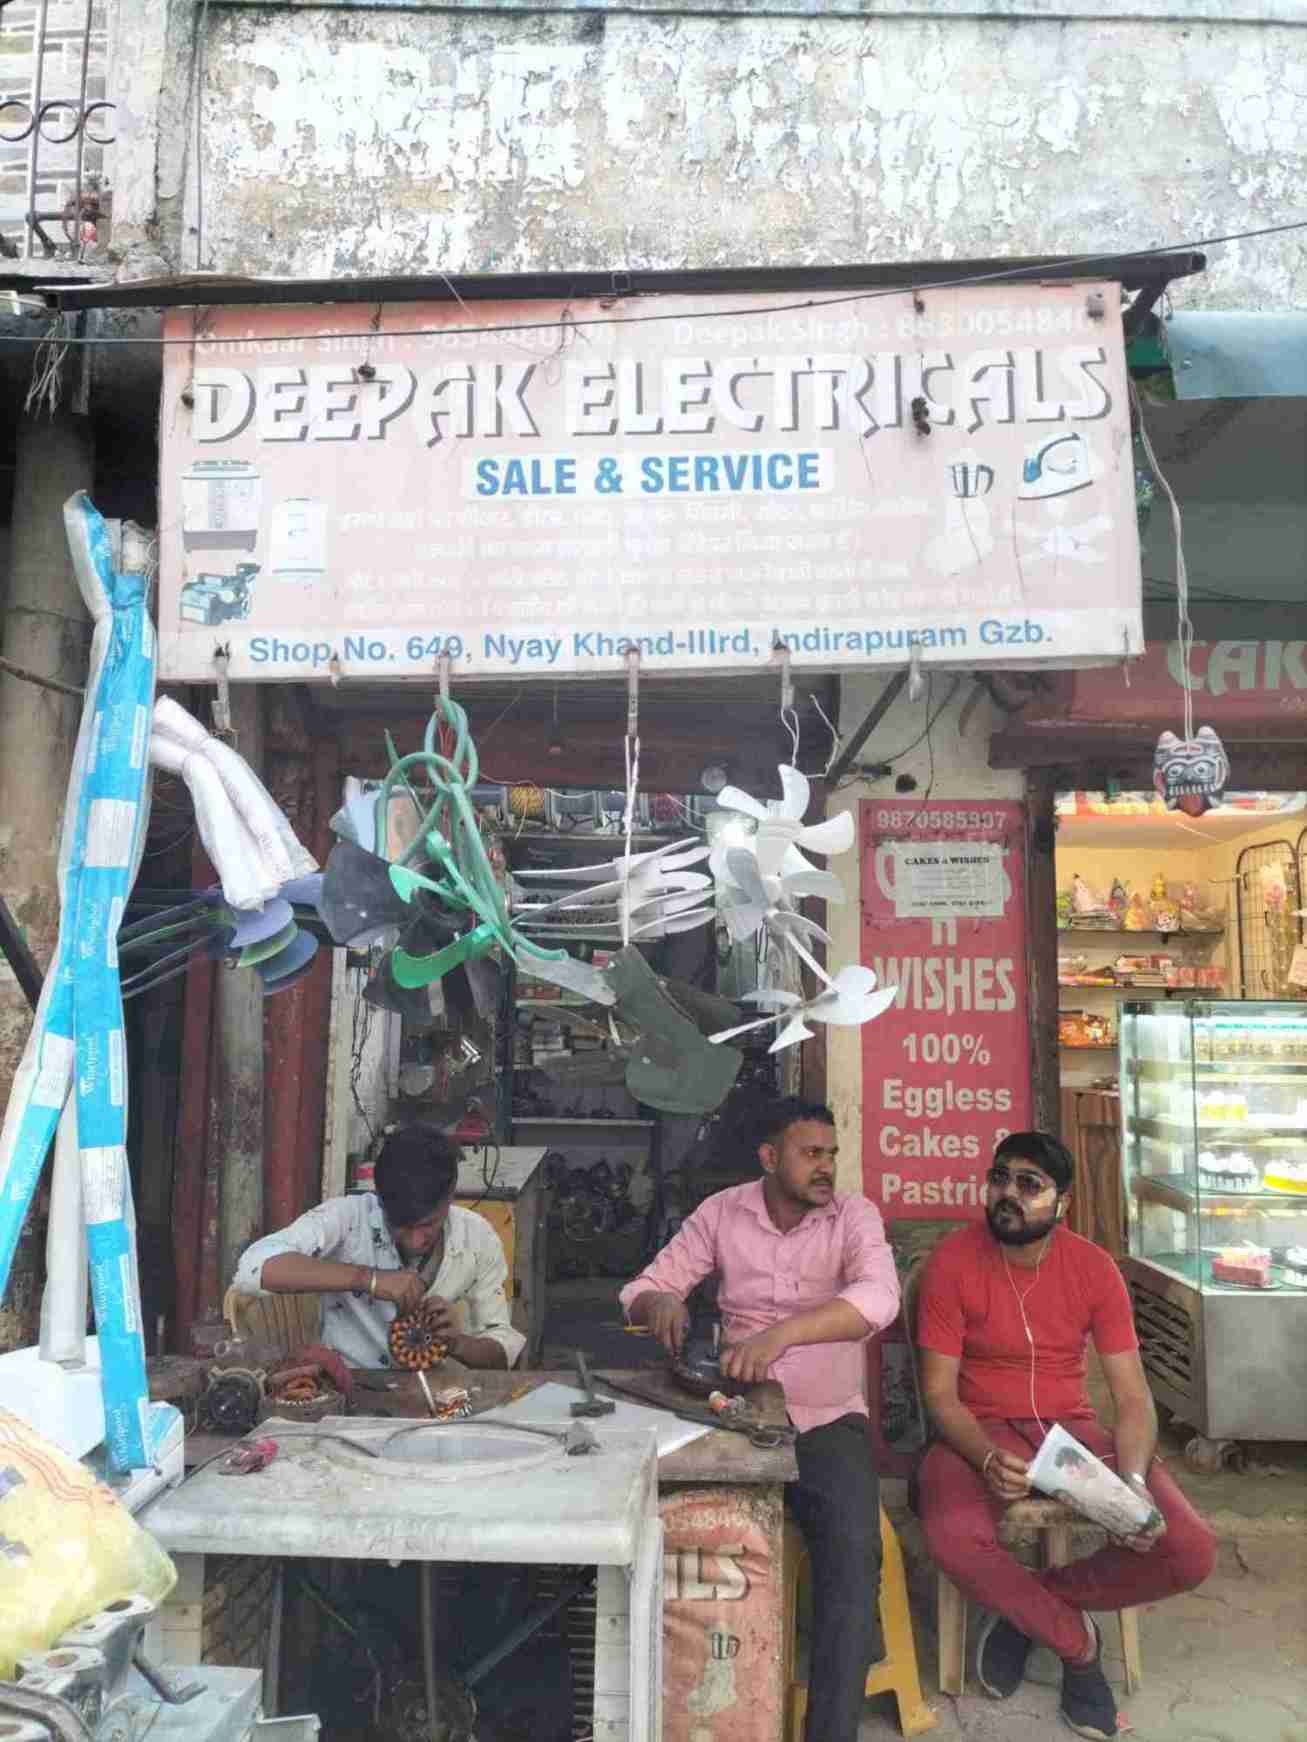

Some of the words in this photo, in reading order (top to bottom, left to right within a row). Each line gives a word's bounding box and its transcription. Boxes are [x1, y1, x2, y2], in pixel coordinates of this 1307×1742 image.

[673, 320, 782, 348] Deepak
[793, 317, 870, 346] Singh
[193, 361, 541, 448] DEEPAK
[573, 347, 1112, 443] ELECTRICALS
[476, 457, 576, 496] SALE
[594, 457, 623, 493] &
[641, 452, 821, 493] SERVICE
[248, 636, 331, 668] Shop
[343, 635, 395, 662] No.
[484, 631, 564, 664] Nyay
[772, 625, 967, 655] Indirapuram
[979, 618, 1053, 644] Gzb.
[874, 956, 1016, 1015] WISHES
[903, 1033, 991, 1065] 100%
[882, 1079, 1012, 1118] Eggless
[879, 1125, 980, 1158] Cakes
